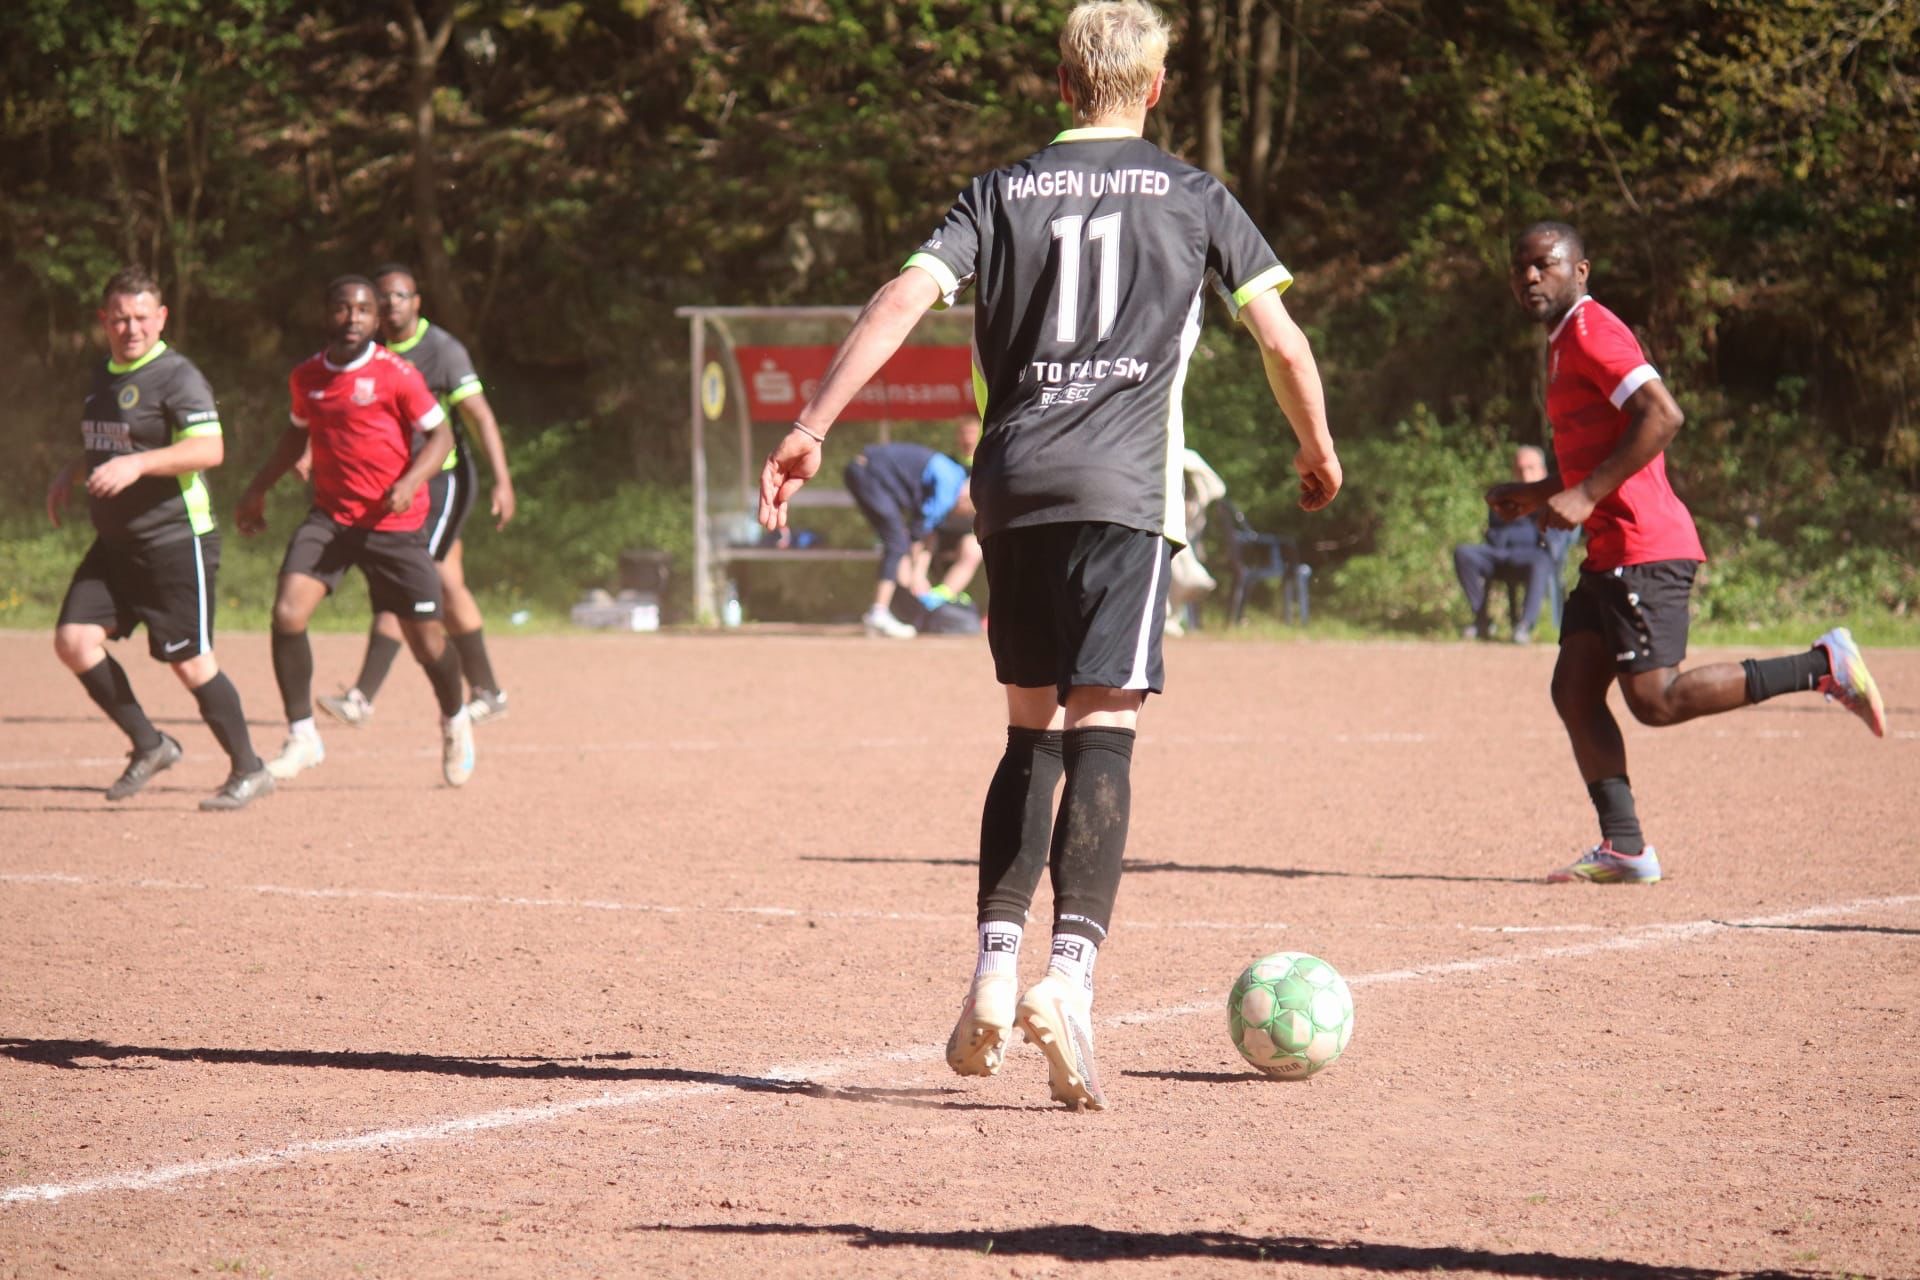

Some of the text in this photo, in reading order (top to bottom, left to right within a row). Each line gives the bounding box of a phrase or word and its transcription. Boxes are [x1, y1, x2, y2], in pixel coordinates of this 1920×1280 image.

[1007, 169, 1170, 201] HAGEN UNITED
[1051, 211, 1122, 342] 11
[1032, 361, 1063, 383] TO
[985, 933, 1017, 954] FS
[1052, 940, 1081, 960] FS
